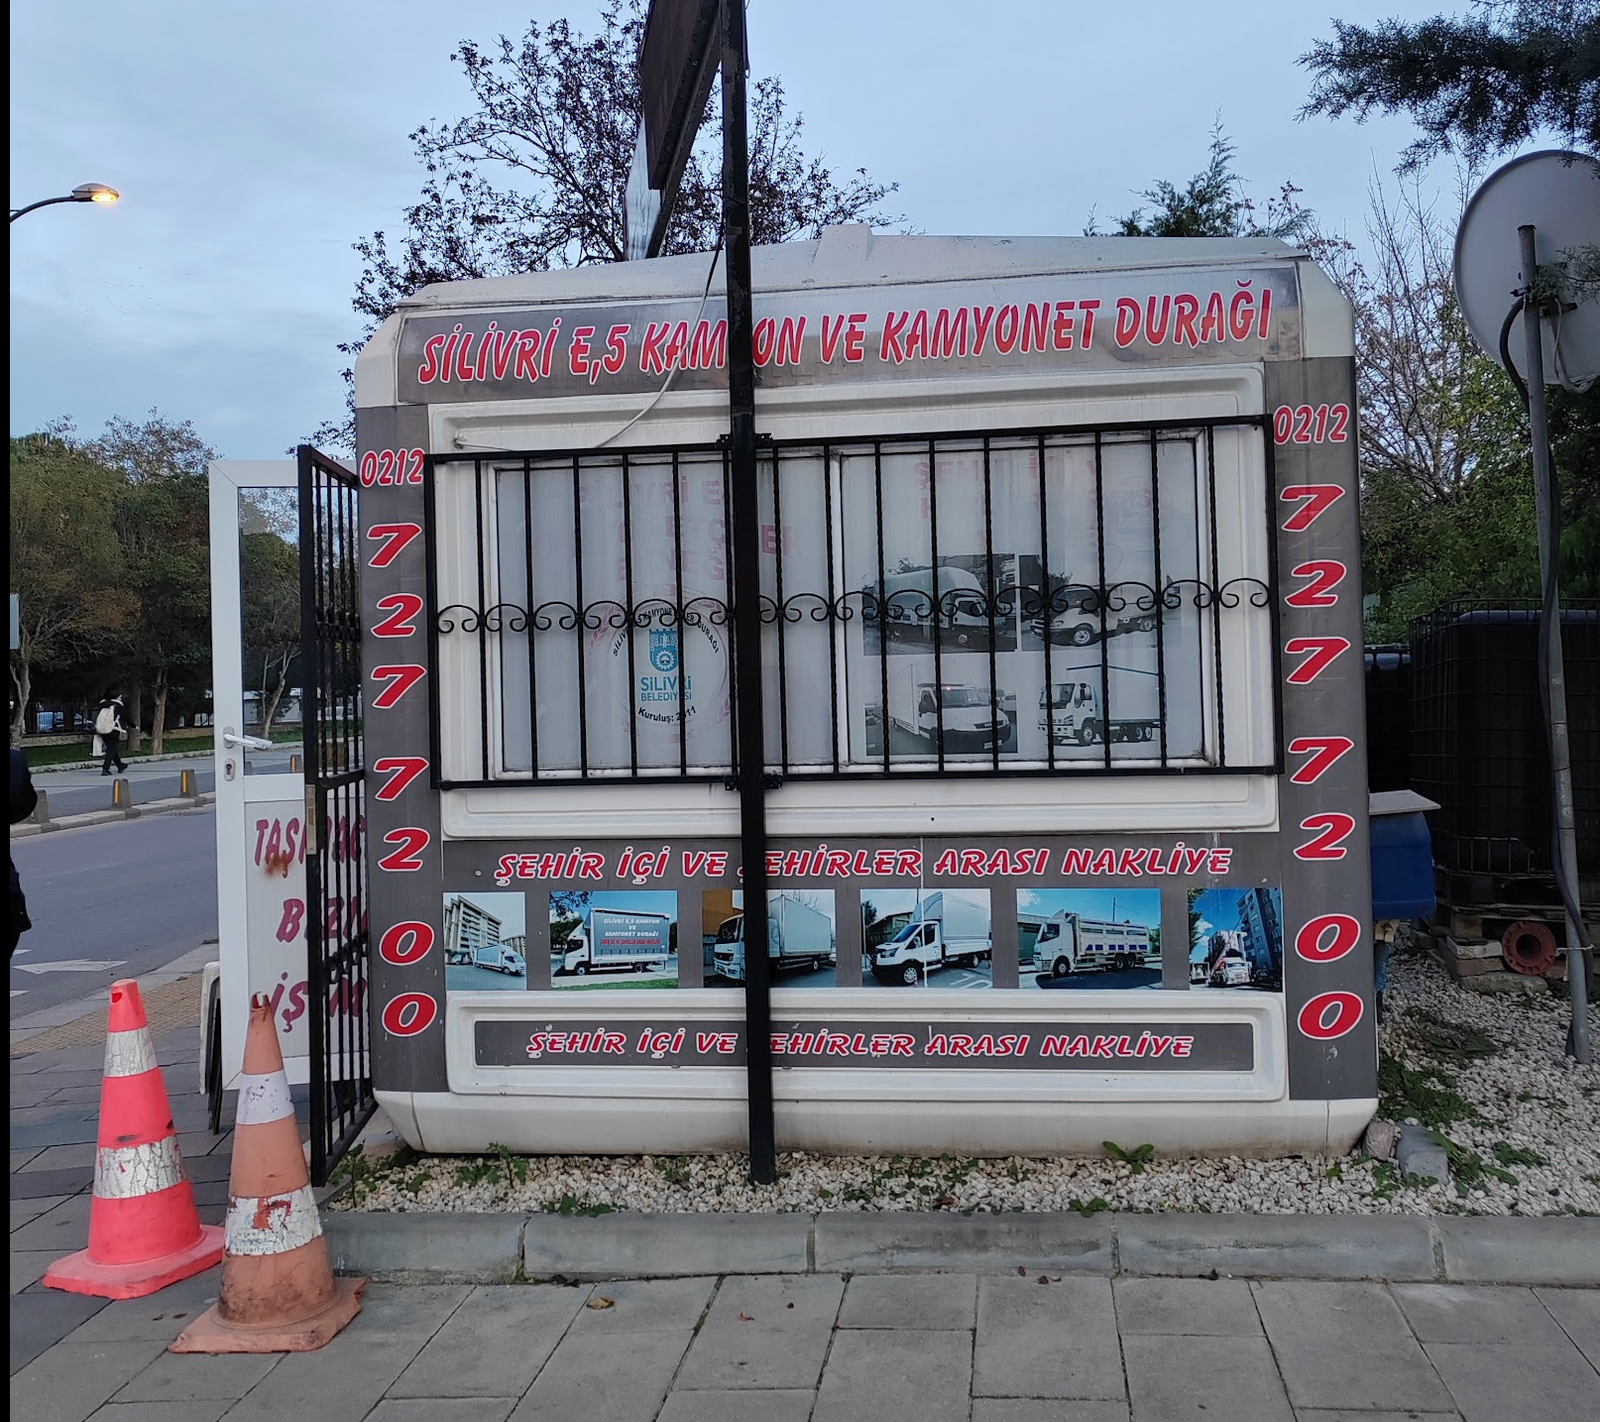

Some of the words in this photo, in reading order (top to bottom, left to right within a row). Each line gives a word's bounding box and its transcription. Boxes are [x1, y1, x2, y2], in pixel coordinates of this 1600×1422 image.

[418, 317, 562, 384] SİLİVRİ
[568, 323, 631, 385] E,5
[639, 314, 806, 375] KAMON
[819, 312, 867, 364] VE
[879, 299, 1101, 364] KAMYONET
[1114, 279, 1272, 348] DURAĞI
[1273, 403, 1349, 444] 0212
[360, 448, 424, 487] 0212
[676, 706, 696, 721] 211
[494, 847, 604, 886] ŞEHİR
[616, 845, 671, 884] İÇİ
[681, 851, 728, 877] VE
[738, 844, 922, 883] EHİRLER
[933, 848, 1050, 876] ARASI
[1061, 842, 1233, 876] NAKLİYE
[526, 1027, 627, 1059] ŞEHİR
[636, 1027, 685, 1059] İÇİ
[695, 1031, 738, 1054] VE
[768, 1027, 915, 1057] EHİRLER
[924, 1033, 1029, 1057] ARASI
[1040, 1030, 1194, 1058] NAKLİYE
